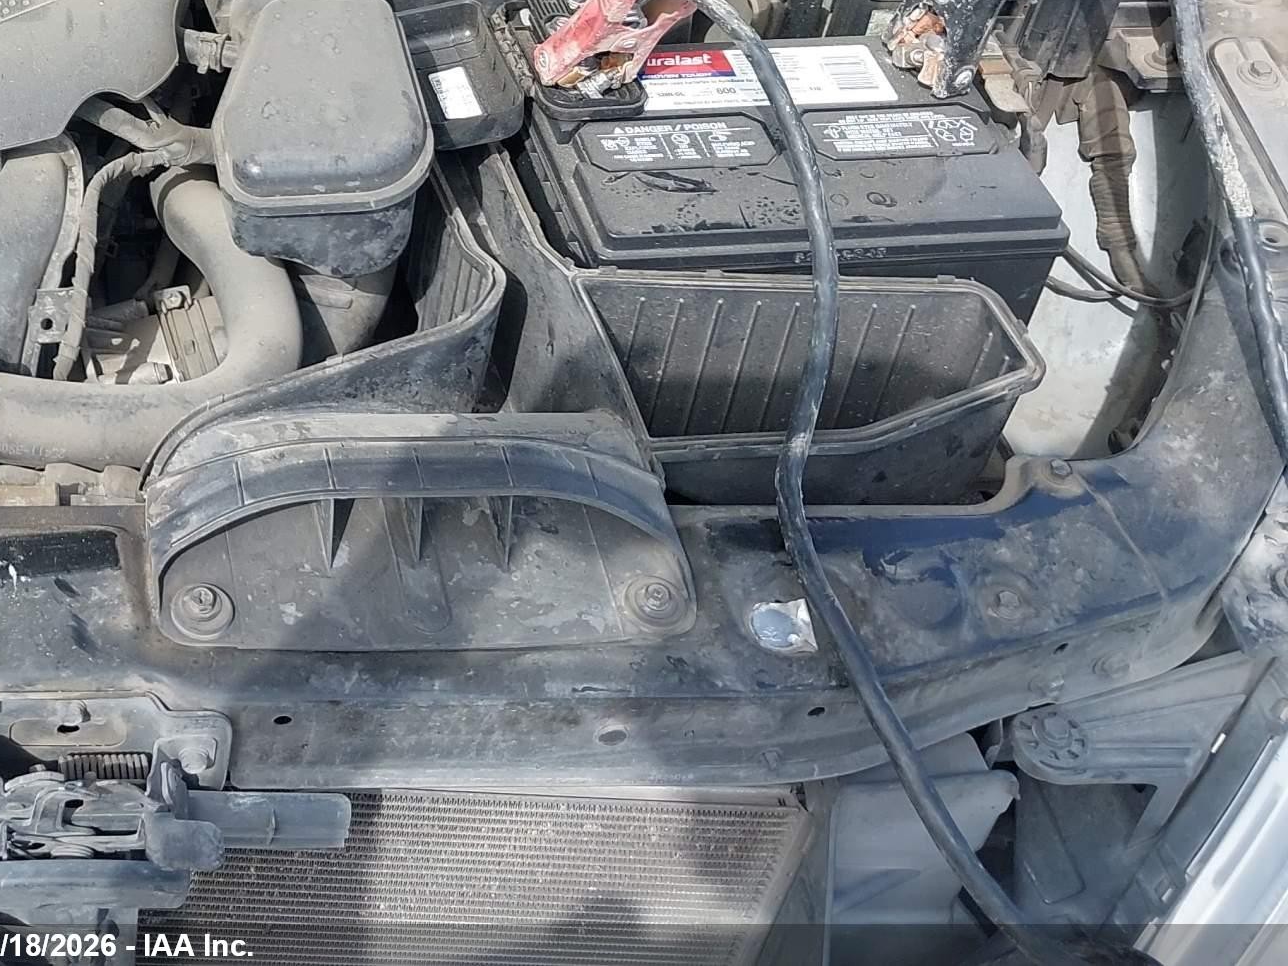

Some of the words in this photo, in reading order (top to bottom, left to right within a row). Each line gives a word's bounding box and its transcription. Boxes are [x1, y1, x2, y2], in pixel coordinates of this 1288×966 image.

[646, 53, 712, 68] uralast
[624, 124, 673, 133] DANGER
[682, 122, 728, 131] POISON
